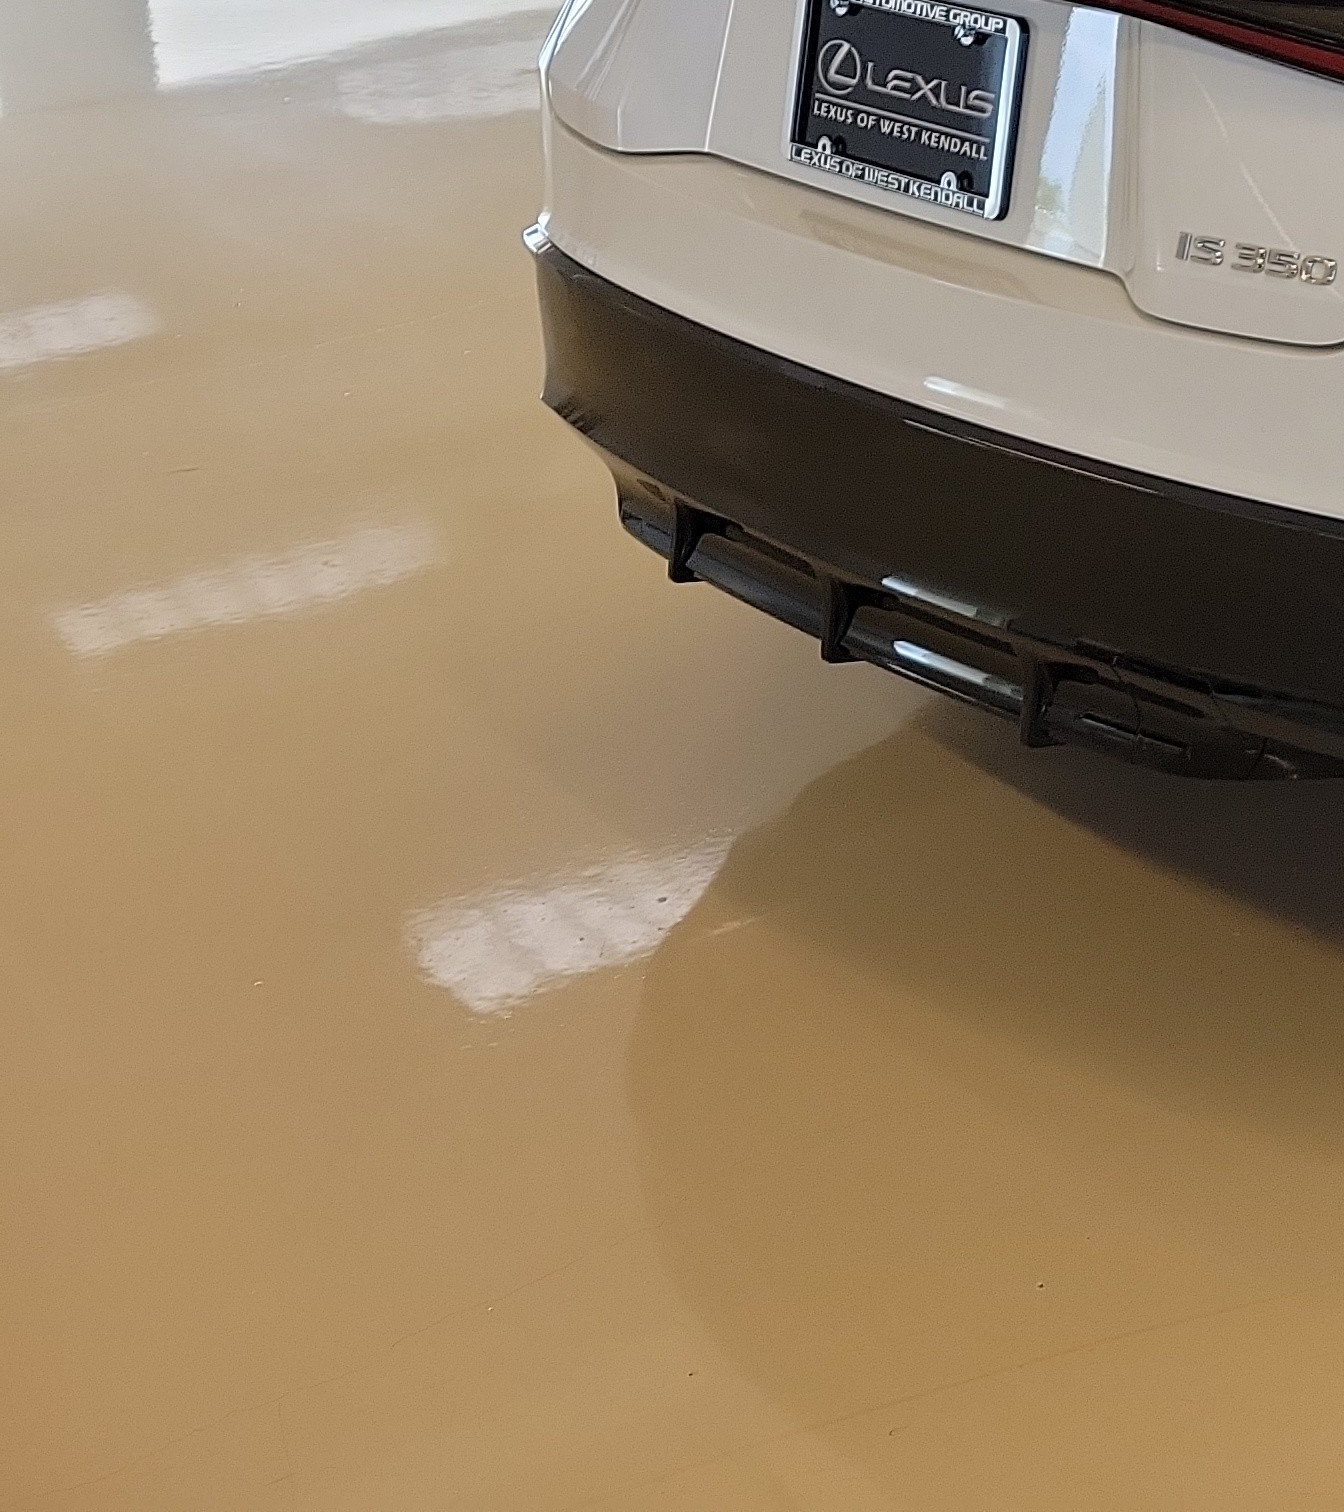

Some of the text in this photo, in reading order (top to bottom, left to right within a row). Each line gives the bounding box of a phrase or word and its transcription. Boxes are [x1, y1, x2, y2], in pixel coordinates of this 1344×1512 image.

[949, 9, 1005, 33] GROUP
[865, 61, 996, 118] LEXUS
[812, 99, 988, 162] LEXUS OF WEST KENDALL
[791, 143, 986, 215] LEXUS OF WEST KENDALL
[1175, 231, 1338, 286] IS 350
